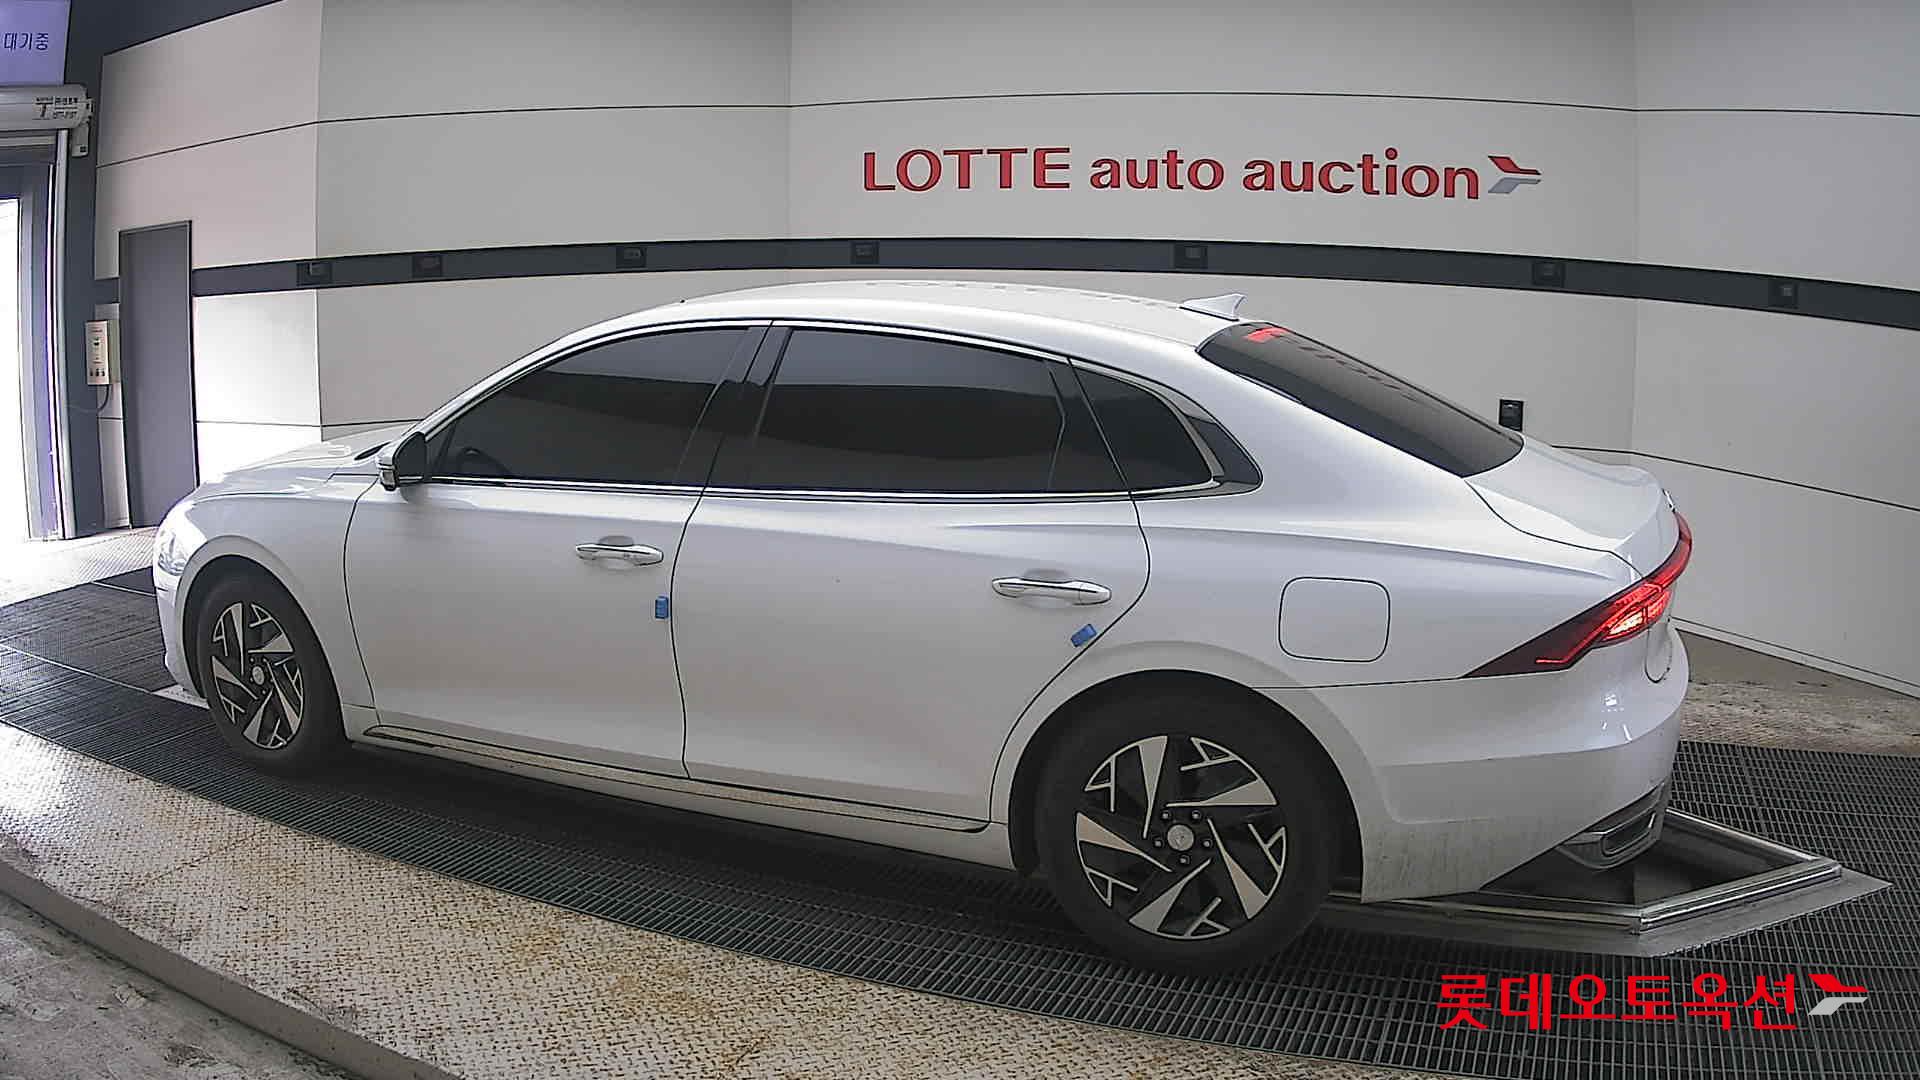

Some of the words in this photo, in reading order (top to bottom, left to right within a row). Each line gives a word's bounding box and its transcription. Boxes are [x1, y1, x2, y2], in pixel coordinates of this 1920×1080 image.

[3, 32, 50, 51] 대기중
[863, 147, 1071, 192] LOTTE
[1089, 149, 1225, 192] auto
[1242, 147, 1480, 200] auction
